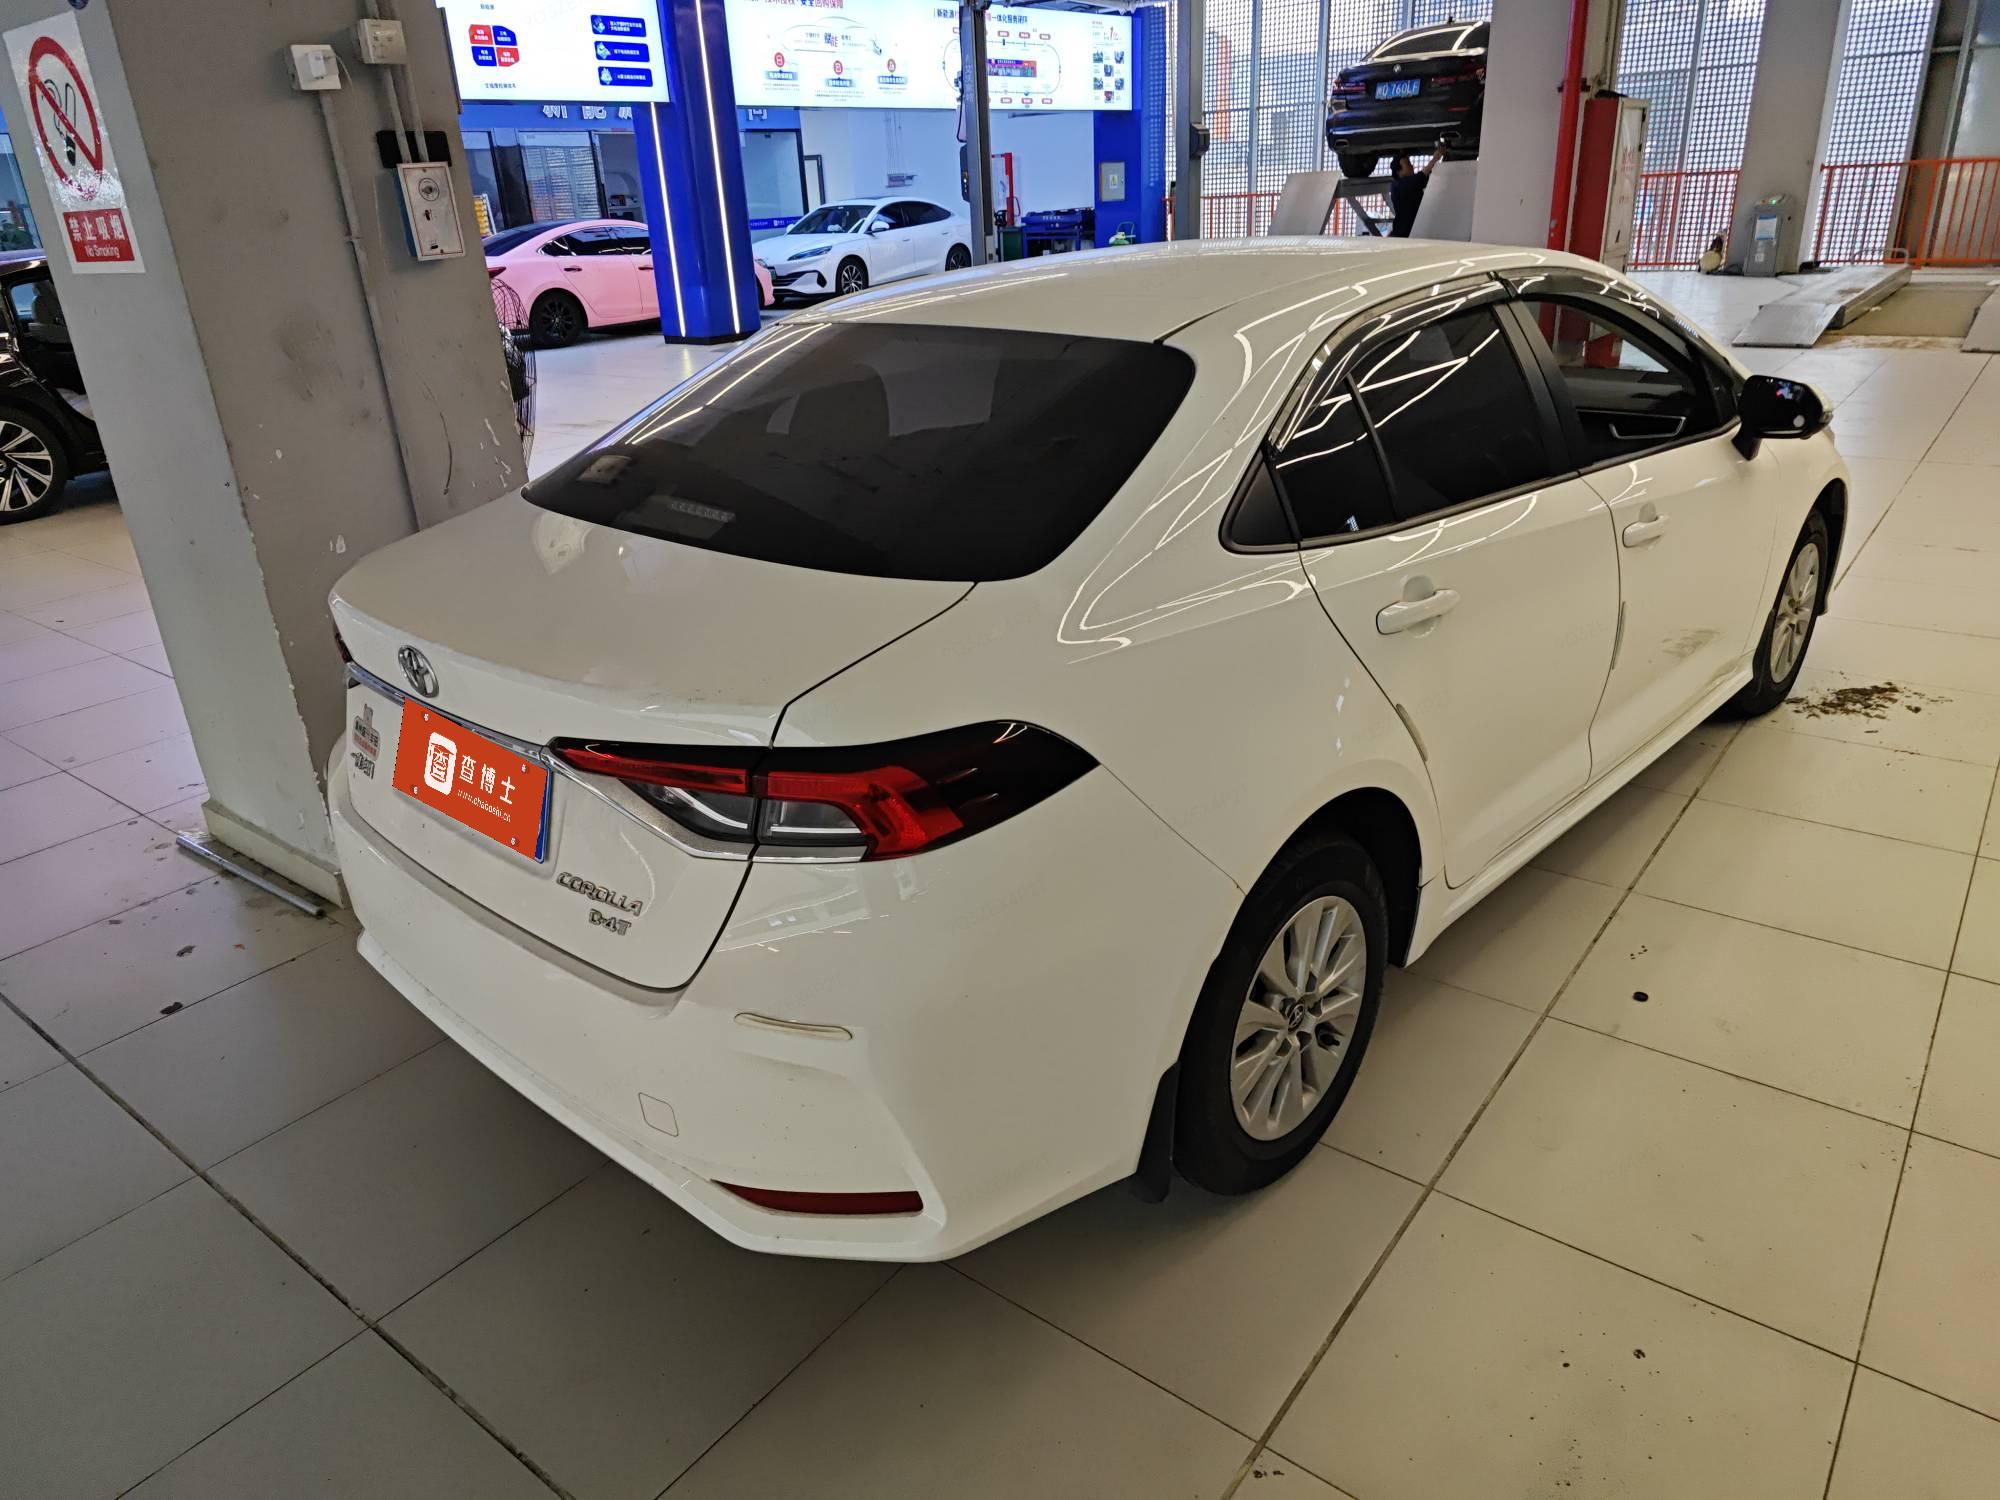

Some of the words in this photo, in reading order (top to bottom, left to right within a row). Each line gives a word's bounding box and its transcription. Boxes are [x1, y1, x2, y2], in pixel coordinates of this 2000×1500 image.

[68, 214, 125, 242] 禁止吸烟
[85, 245, 95, 257] No
[95, 244, 120, 258] Smoking
[556, 871, 643, 917] COROLLA
